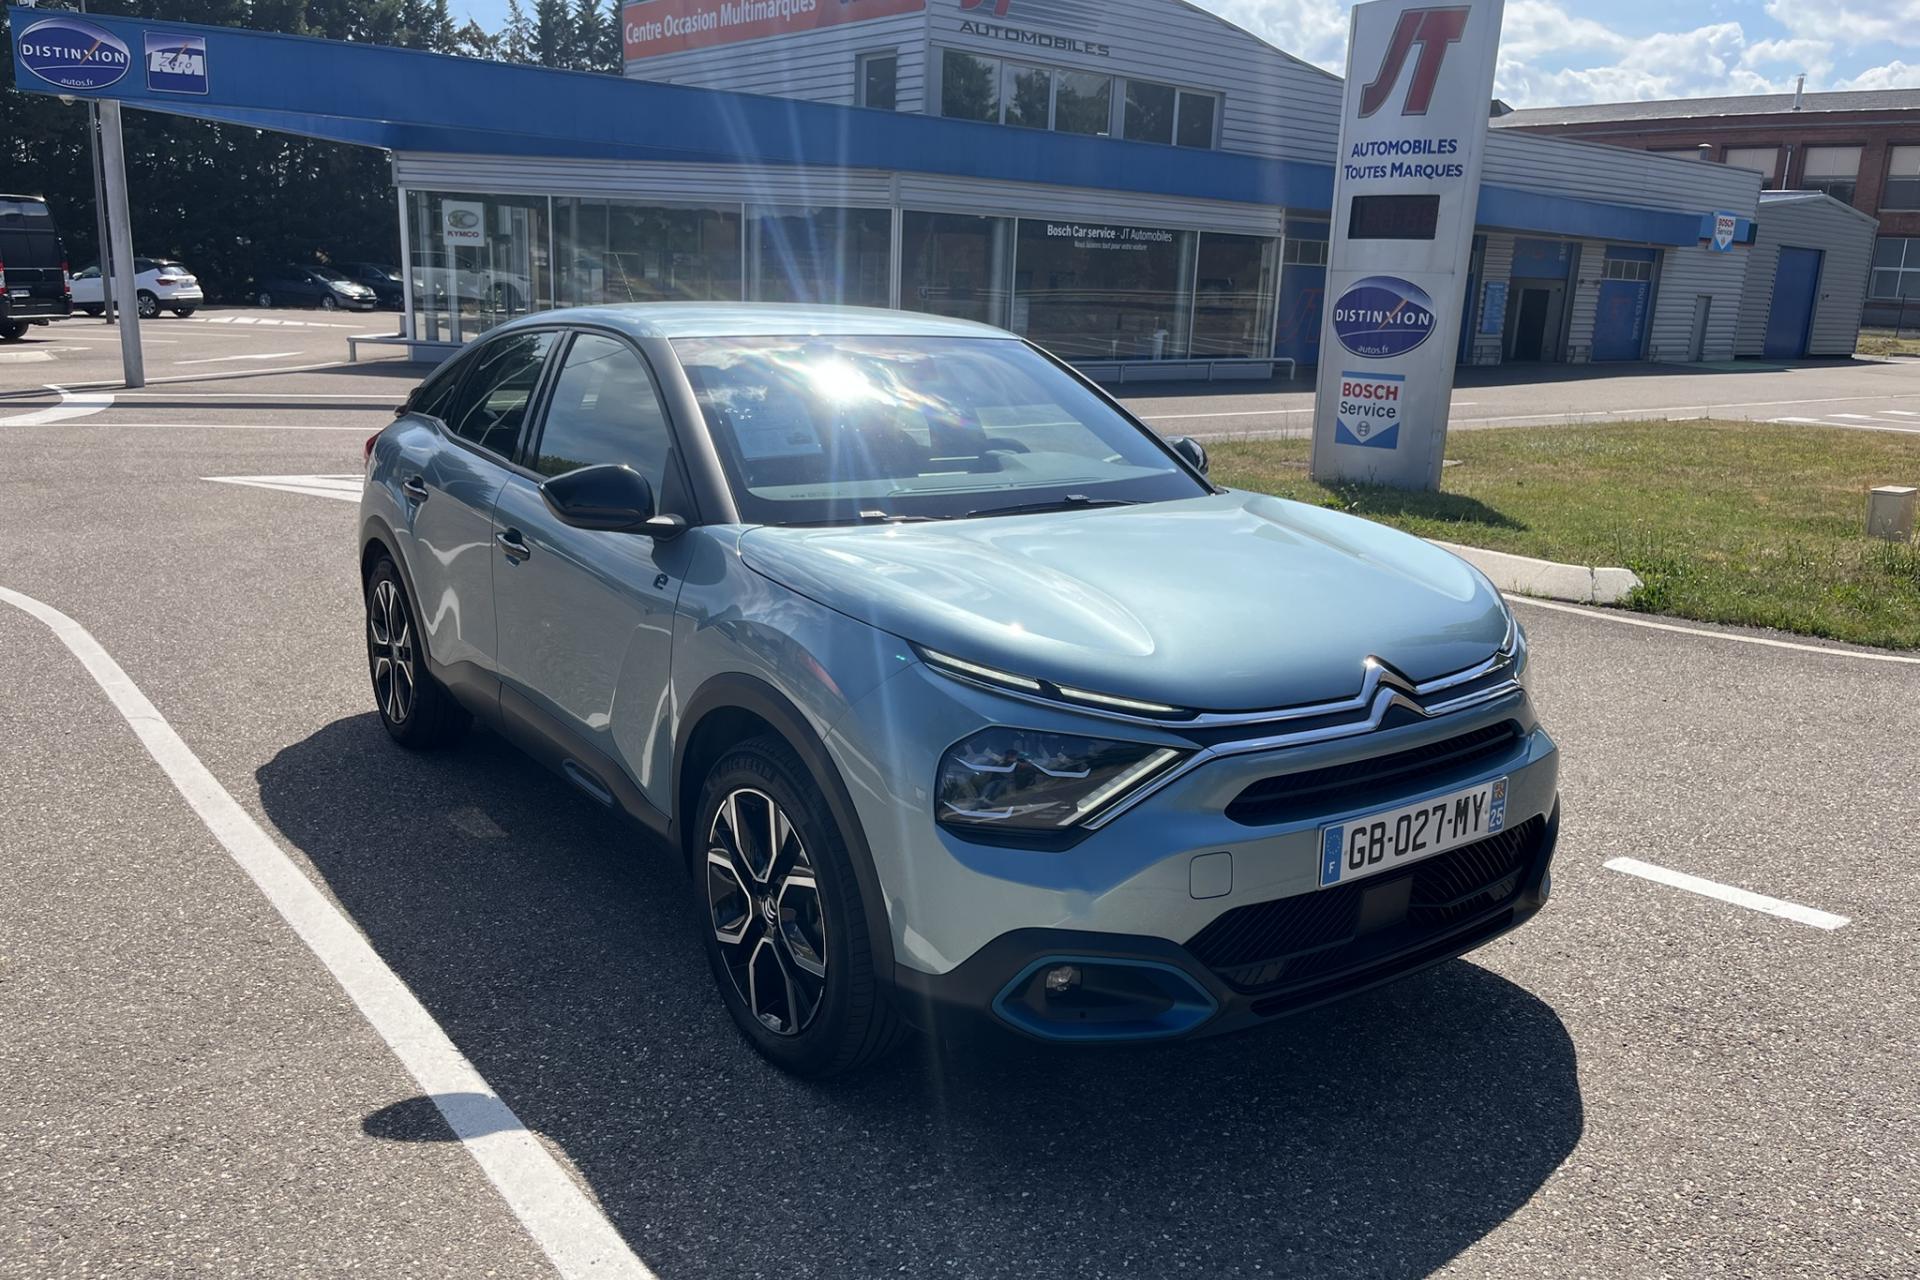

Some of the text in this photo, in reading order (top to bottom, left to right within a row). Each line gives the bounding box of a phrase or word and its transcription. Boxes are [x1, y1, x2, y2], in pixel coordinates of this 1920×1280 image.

[626, 0, 816, 45] Centre Occasion Multimarques
[959, 21, 1110, 57] AUTOMOBILES
[22, 44, 125, 64] DISTINXION
[60, 77, 94, 87] autos.fr
[1351, 139, 1458, 158] AUTOMOBILES
[448, 230, 480, 238] KYMCO
[1047, 224, 1072, 237] Bosch
[1073, 225, 1086, 238] Car
[1088, 227, 1116, 239] service
[1121, 228, 1130, 240] JT
[1131, 229, 1173, 242] Automobiles
[1335, 309, 1430, 326] DISTINXION
[1356, 344, 1389, 354] autos.fr
[1342, 382, 1399, 401] BOSCH
[1339, 401, 1397, 419] Service
[1489, 806, 1504, 827] 25
[1348, 791, 1487, 870] GB-027-MY
[1328, 861, 1336, 874] F
